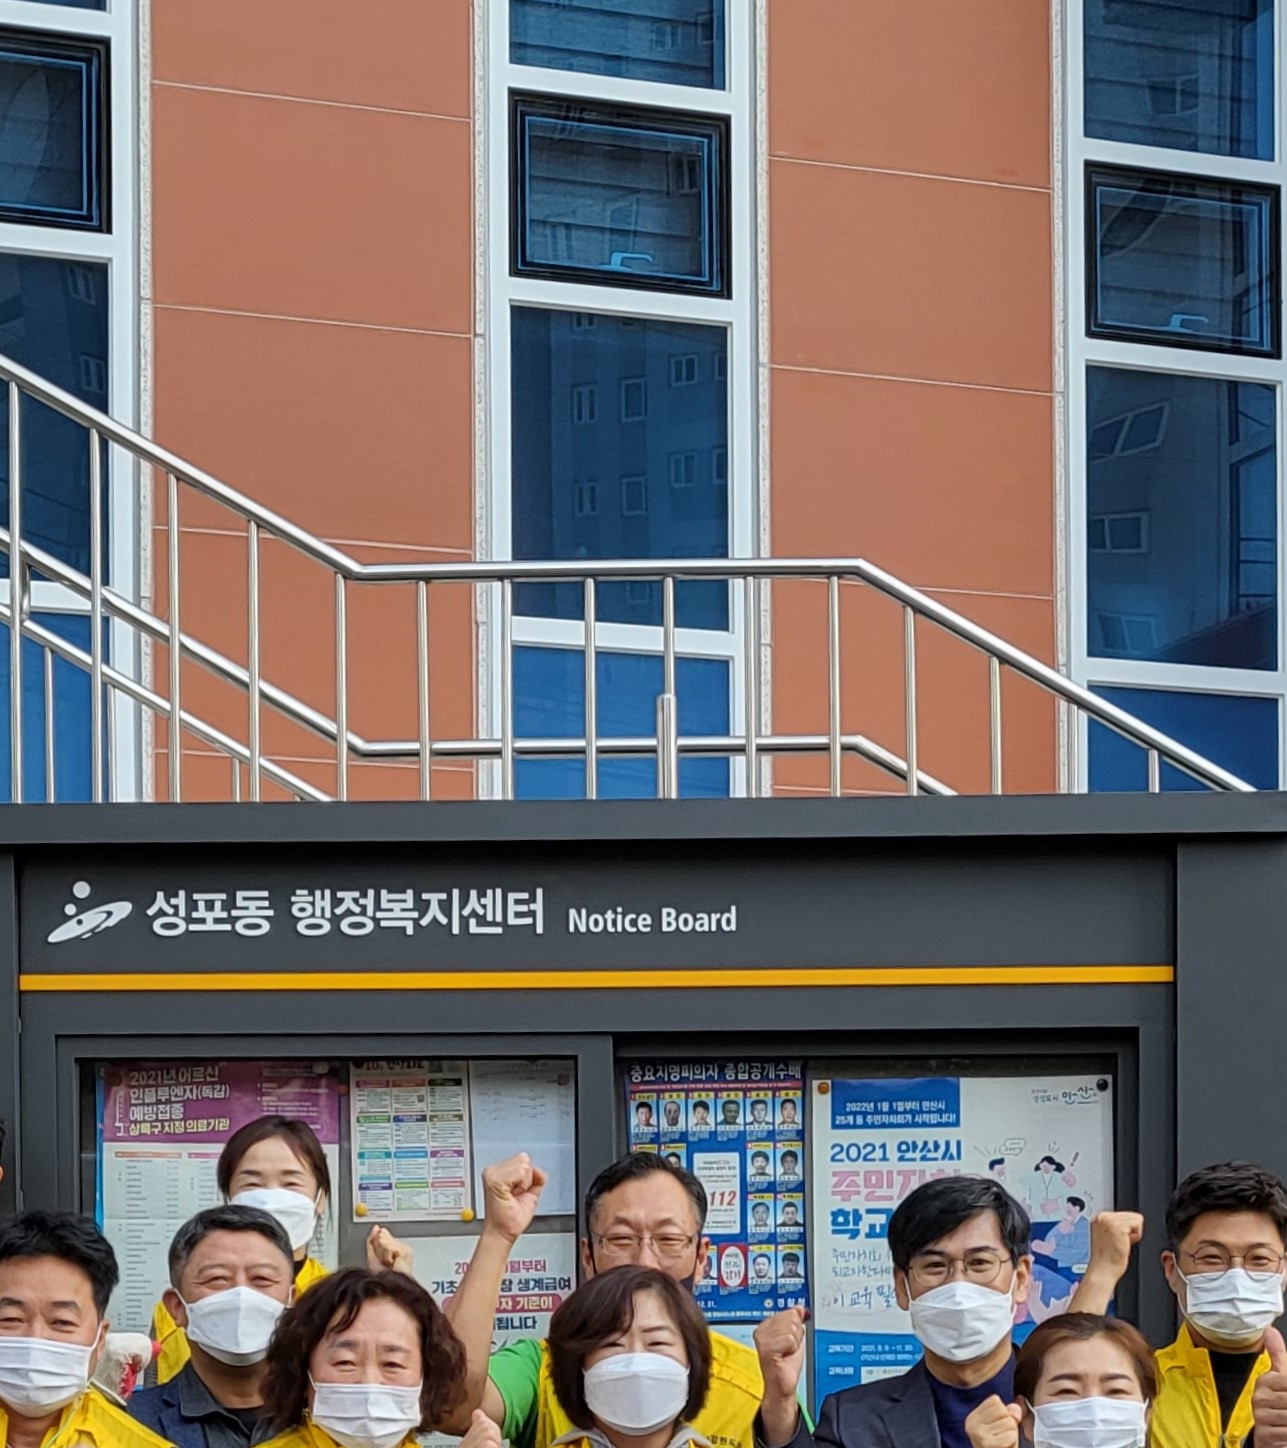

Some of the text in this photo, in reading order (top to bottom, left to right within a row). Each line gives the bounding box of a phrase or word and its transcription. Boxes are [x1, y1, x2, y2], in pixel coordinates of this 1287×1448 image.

[145, 886, 544, 937] 성포동 행정복지센터
[567, 905, 738, 934] Notice Board
[130, 1066, 219, 1085] 2021년 어르신
[630, 1061, 802, 1083] 중요지명피의자 종합공개수배
[129, 1103, 184, 1121] 예방접종
[845, 1101, 874, 1112] 2022년
[922, 1099, 946, 1111] 안산시
[835, 1115, 854, 1126] 25개
[830, 1139, 962, 1162] 2021 안산시
[831, 1168, 961, 1202] 주민자
[709, 1190, 738, 1208] 112
[830, 1208, 894, 1240] 학교
[517, 1277, 572, 1292] 생계급여
[515, 1296, 553, 1310] 기준이
[493, 1315, 537, 1330] 됩니다
